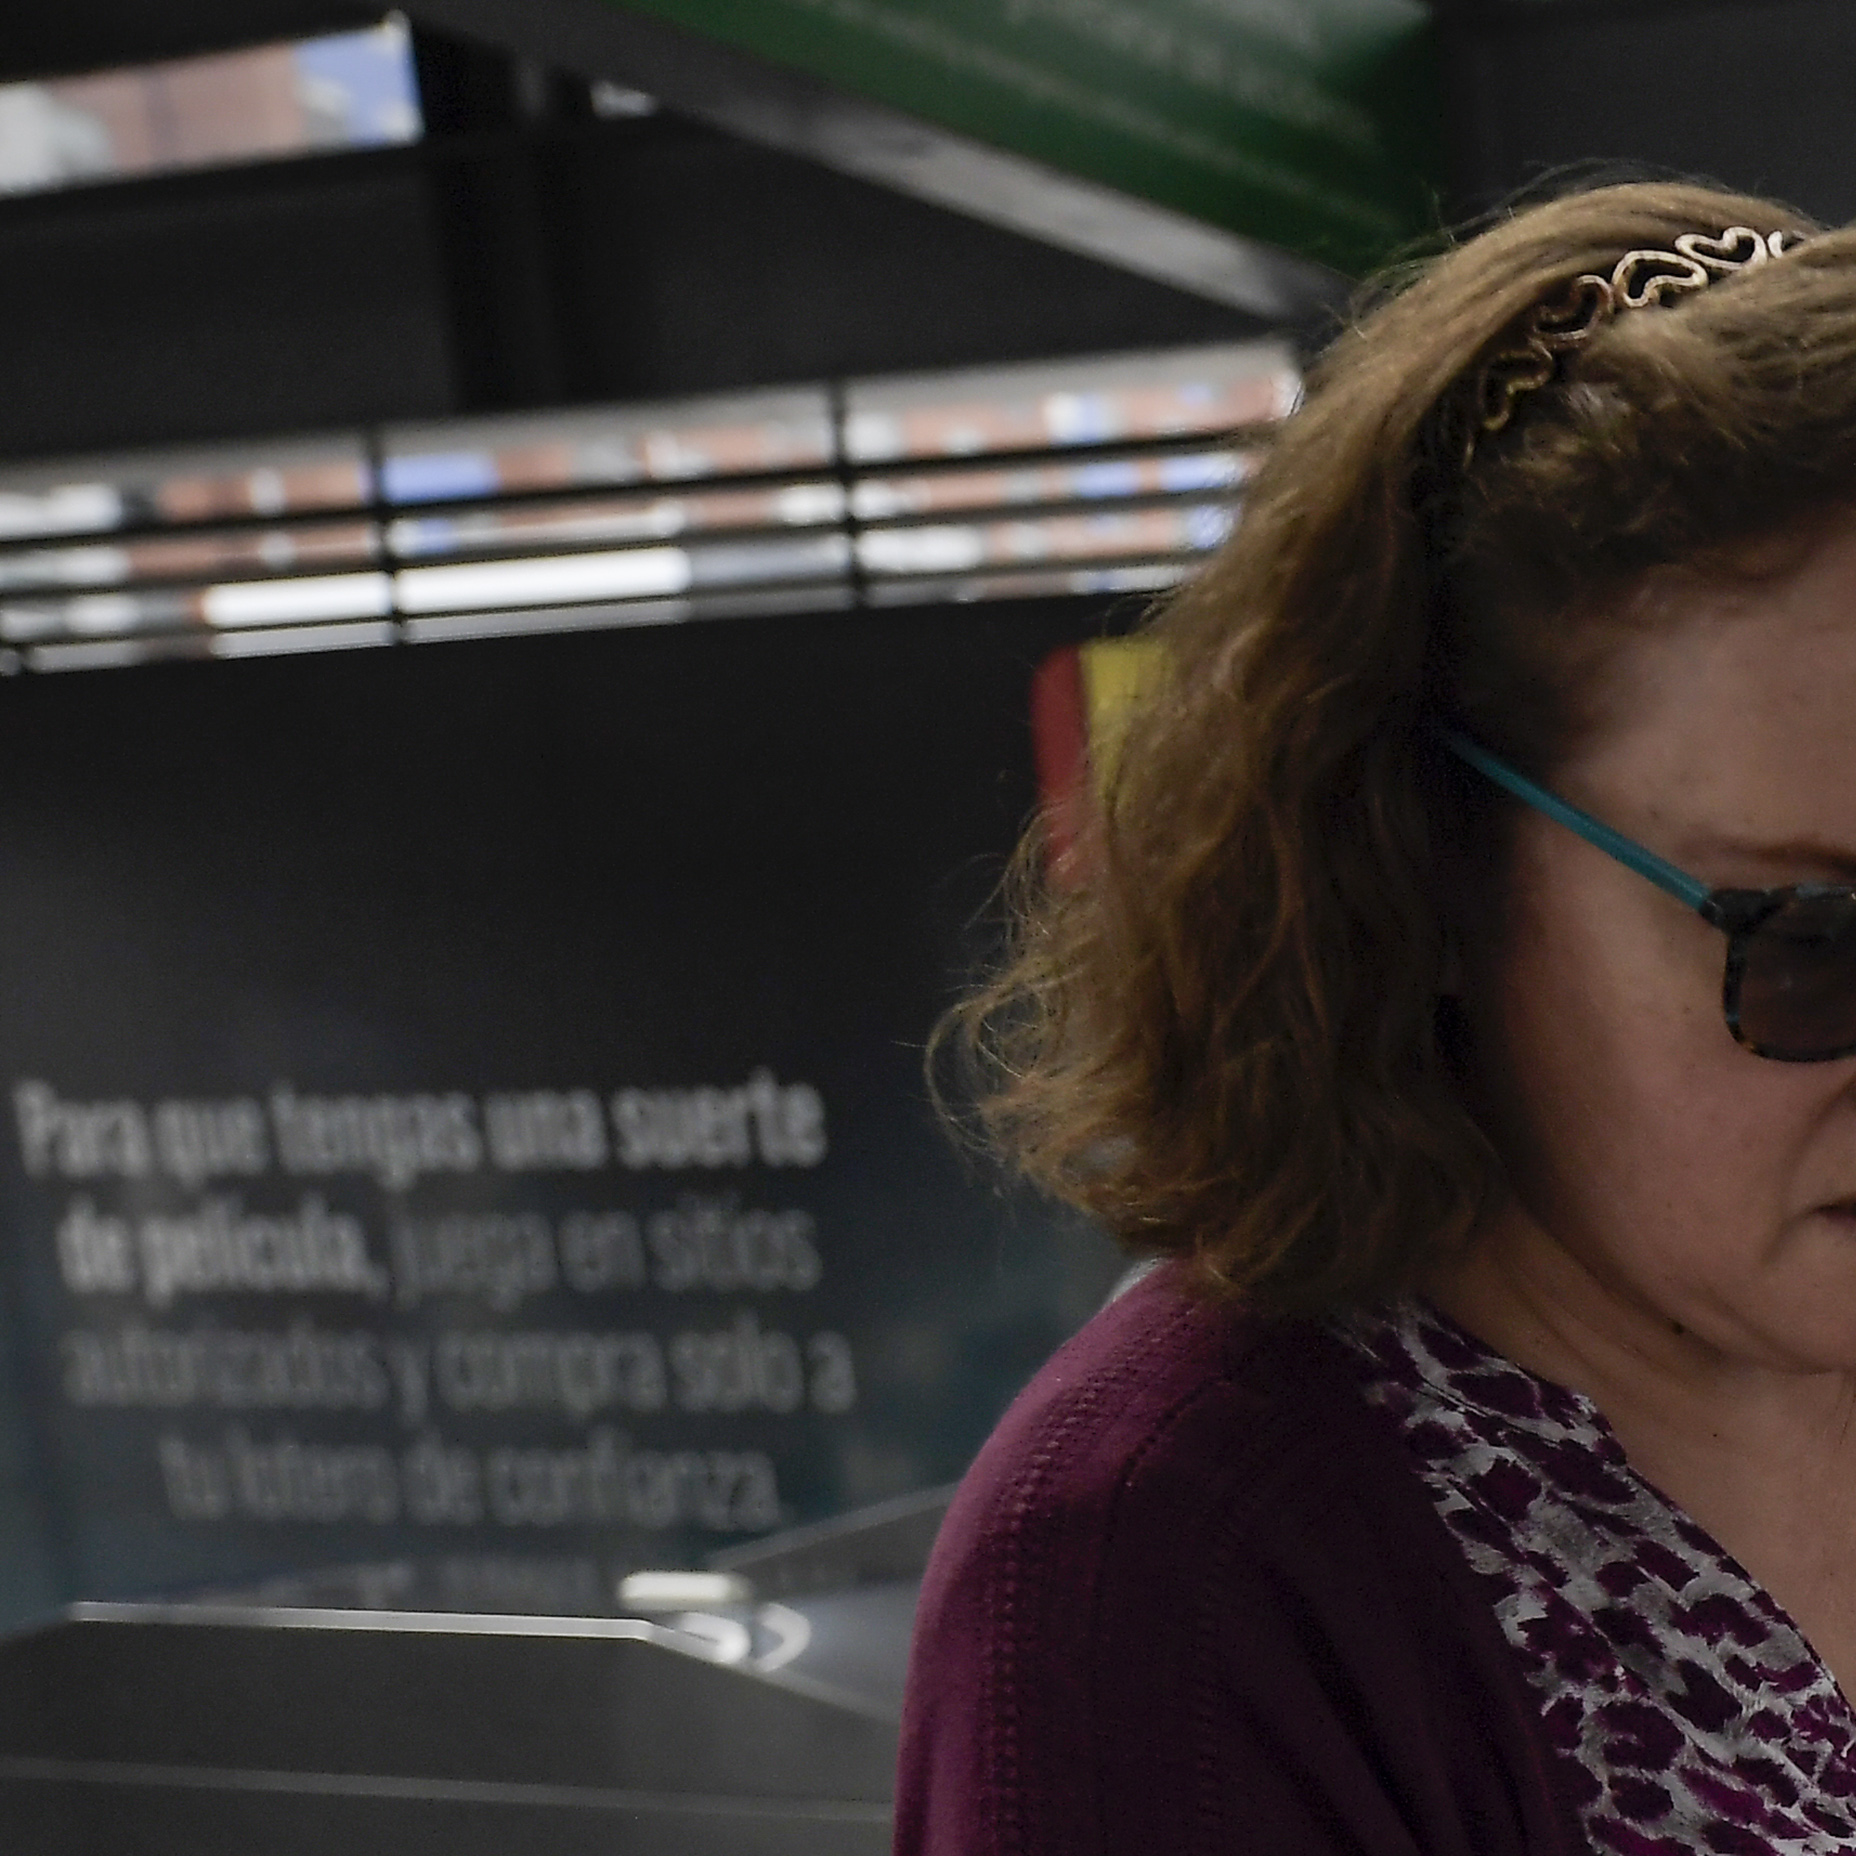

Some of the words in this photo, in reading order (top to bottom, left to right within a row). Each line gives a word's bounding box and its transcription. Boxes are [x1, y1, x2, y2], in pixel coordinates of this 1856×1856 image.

[10, 1082, 150, 1178] Para
[153, 1098, 266, 1186] que
[269, 1084, 478, 1190] tengas
[484, 1090, 608, 1172] una
[612, 1068, 828, 1170] suerte
[58, 1198, 132, 1294] de
[392, 1205, 556, 1311] juega
[560, 1208, 644, 1293] en
[647, 1195, 823, 1293] sitios
[62, 1316, 390, 1408] autorizados
[396, 1340, 430, 1426] y
[436, 1330, 667, 1424] compra
[807, 1329, 856, 1412] a
[158, 1434, 229, 1520] tu
[404, 1430, 481, 1526] de
